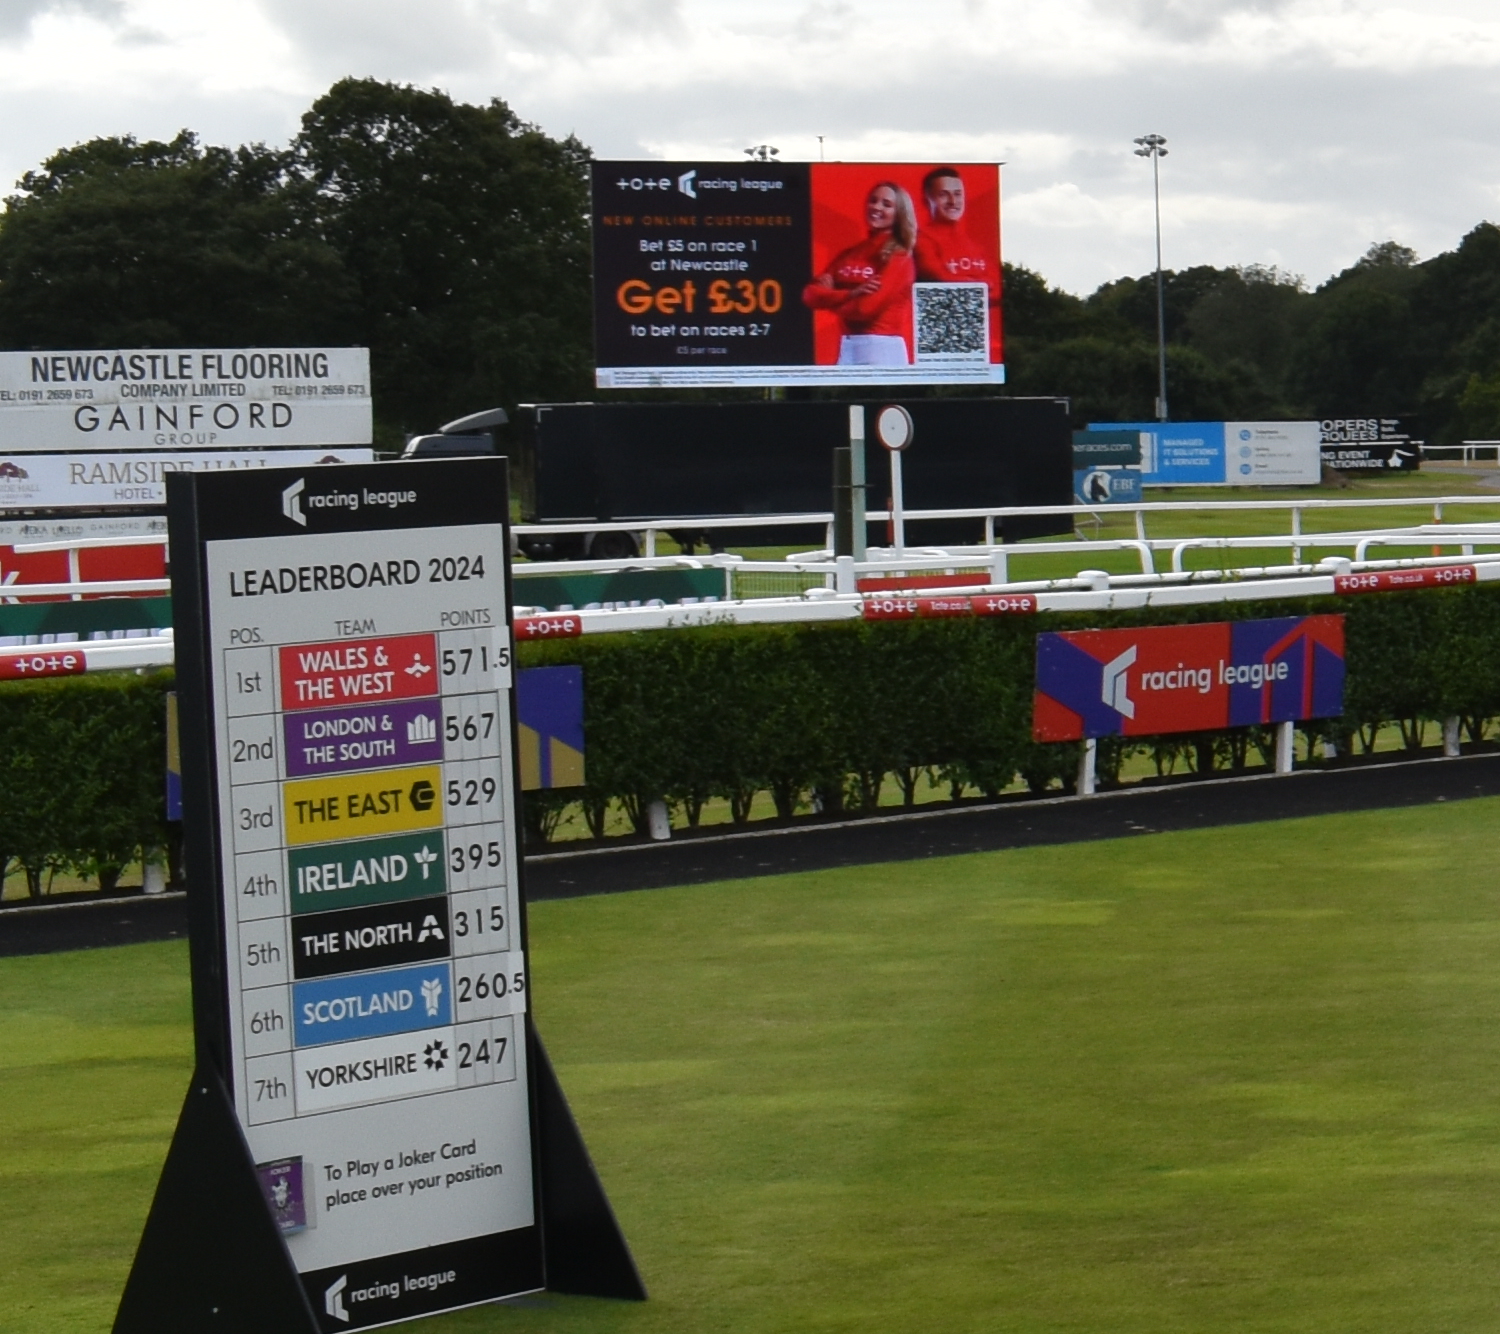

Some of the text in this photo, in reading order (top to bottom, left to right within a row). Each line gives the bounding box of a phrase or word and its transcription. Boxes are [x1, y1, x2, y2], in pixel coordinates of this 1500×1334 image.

[698, 178, 783, 191] racing league
[603, 217, 792, 225] NEW ONLINE CUSTOMERS
[639, 240, 757, 251] Bet £5 on race 1
[650, 259, 748, 271] at Newcastle
[617, 279, 782, 313] Get £30
[631, 323, 770, 336] to bet on races 2-7
[31, 353, 328, 382] NEWCASTLE FLOORING
[19, 390, 43, 400] 0191
[75, 389, 94, 399] 673
[121, 383, 245, 397] COMPANY LIMITED
[272, 385, 293, 395] TEL:
[348, 384, 366, 395] 673
[75, 403, 292, 432] GAINFORD
[1320, 419, 1379, 431] OPERS
[154, 433, 217, 445] GROUP
[1173, 448, 1218, 456] SOLUTIONS
[1172, 458, 1210, 466] SERVICES
[1338, 450, 1370, 459] EVENT
[115, 488, 154, 499] HOTEL
[1113, 479, 1135, 490] EBF
[309, 487, 416, 510] racing league
[230, 554, 485, 597] LEADERBOARD 2024
[230, 609, 491, 644] POS. TEAM POINTS
[299, 646, 388, 673] WALES &
[442, 647, 510, 676] 571.5
[236, 671, 261, 694] 1st
[294, 671, 395, 701] THE WEST
[1141, 659, 1289, 694] racing league
[304, 714, 393, 740] LONDON &
[445, 712, 495, 742] 567
[232, 736, 273, 763] 2nd
[304, 739, 395, 764] THE SOUTH
[448, 776, 496, 806] 529
[240, 804, 273, 830] 3rd
[294, 789, 402, 824] THE EAST
[243, 841, 501, 899] 4th IRELAND 395
[247, 905, 504, 966] 5th THE NORTH 315
[250, 972, 525, 1034] 6th SCOTLAND 260.5
[254, 1037, 507, 1101] 7th YORKSHIRE 247
[324, 1140, 477, 1181] To Play a Joker Card
[326, 1163, 503, 1211] place over your position
[351, 1269, 456, 1302] racing league
